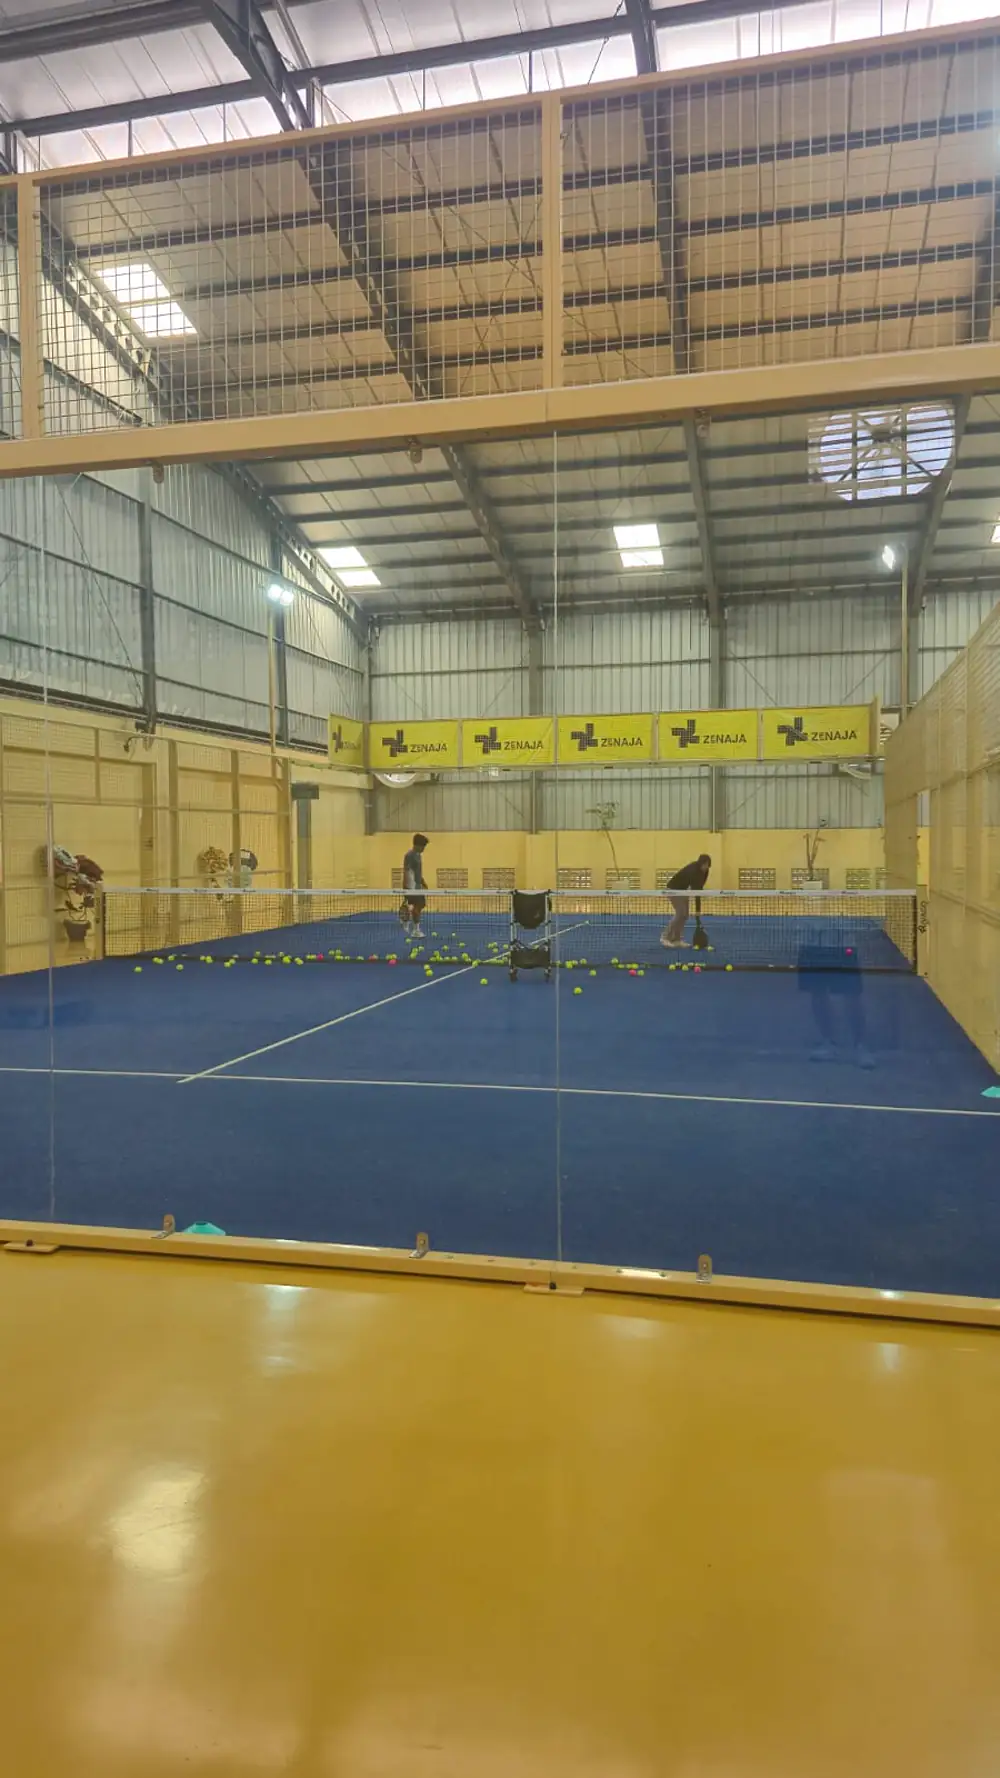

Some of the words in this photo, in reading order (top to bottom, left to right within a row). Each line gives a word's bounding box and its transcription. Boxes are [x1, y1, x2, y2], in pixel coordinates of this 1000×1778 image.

[703, 734, 747, 744] ZENAJA
[811, 730, 857, 741] ZENAJA
[504, 740, 544, 750] ZENAJA
[601, 737, 643, 748] ZENAJA
[410, 743, 447, 753] ZENAJA
